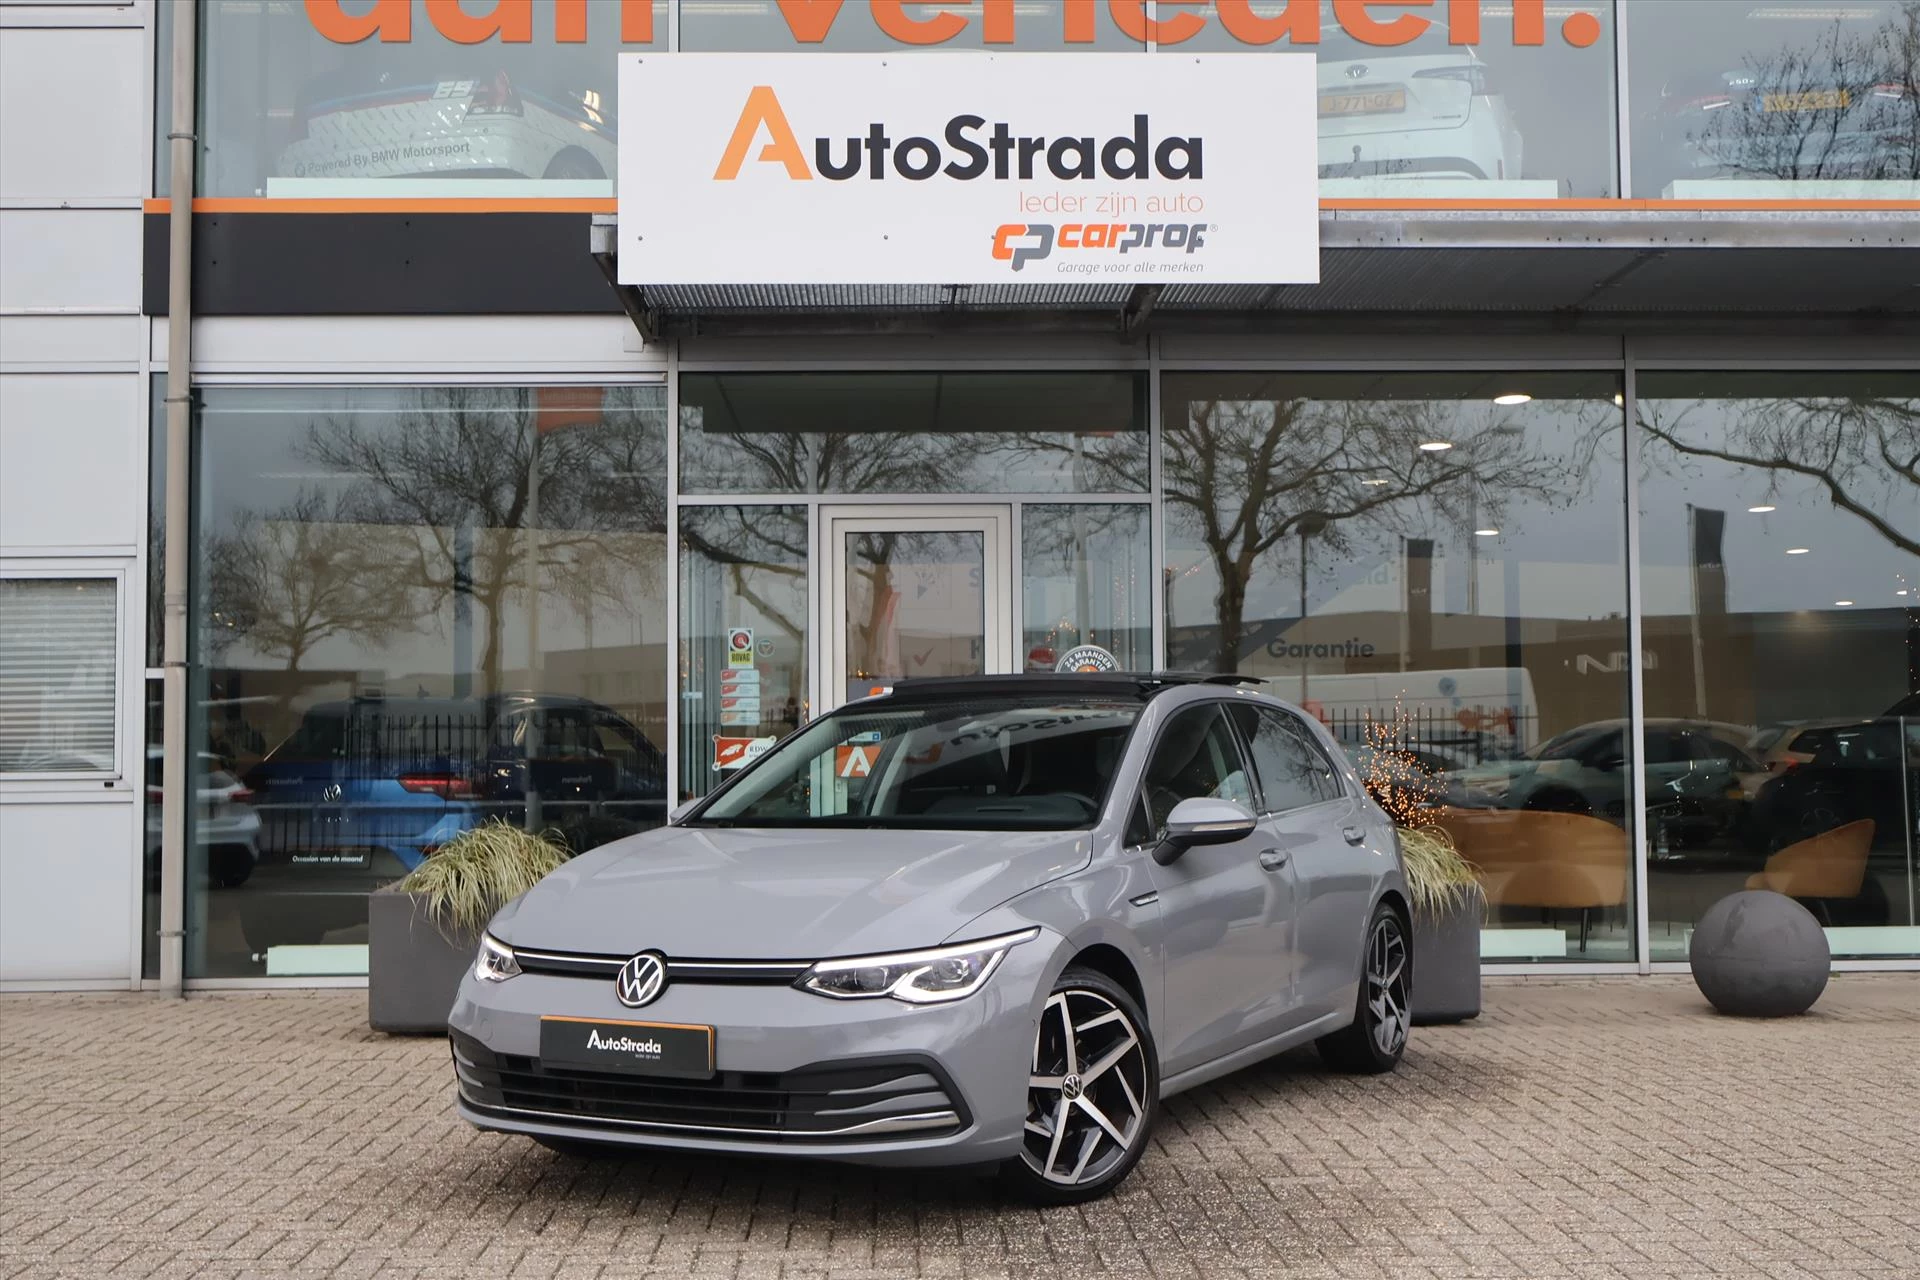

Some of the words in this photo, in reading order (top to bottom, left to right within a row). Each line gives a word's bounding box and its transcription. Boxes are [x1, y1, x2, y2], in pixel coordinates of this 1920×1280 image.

[712, 85, 1203, 181] AutoStrada
[354, 153, 369, 168] By
[371, 149, 400, 163] BMW
[402, 142, 471, 159] Motorsport
[1019, 191, 1087, 213] Ieder
[1095, 191, 1137, 218] zijn
[1146, 195, 1204, 213] auto
[1057, 262, 1100, 275] Garage
[1104, 263, 1131, 272] voor
[1134, 262, 1155, 272] alle
[1159, 262, 1204, 272] merken
[1267, 637, 1375, 658] Garantie
[1074, 651, 1113, 668] MAANDEN
[292, 855, 318, 863] Occasion
[341, 855, 363, 863] maand
[587, 1029, 662, 1054] AutoStrada
